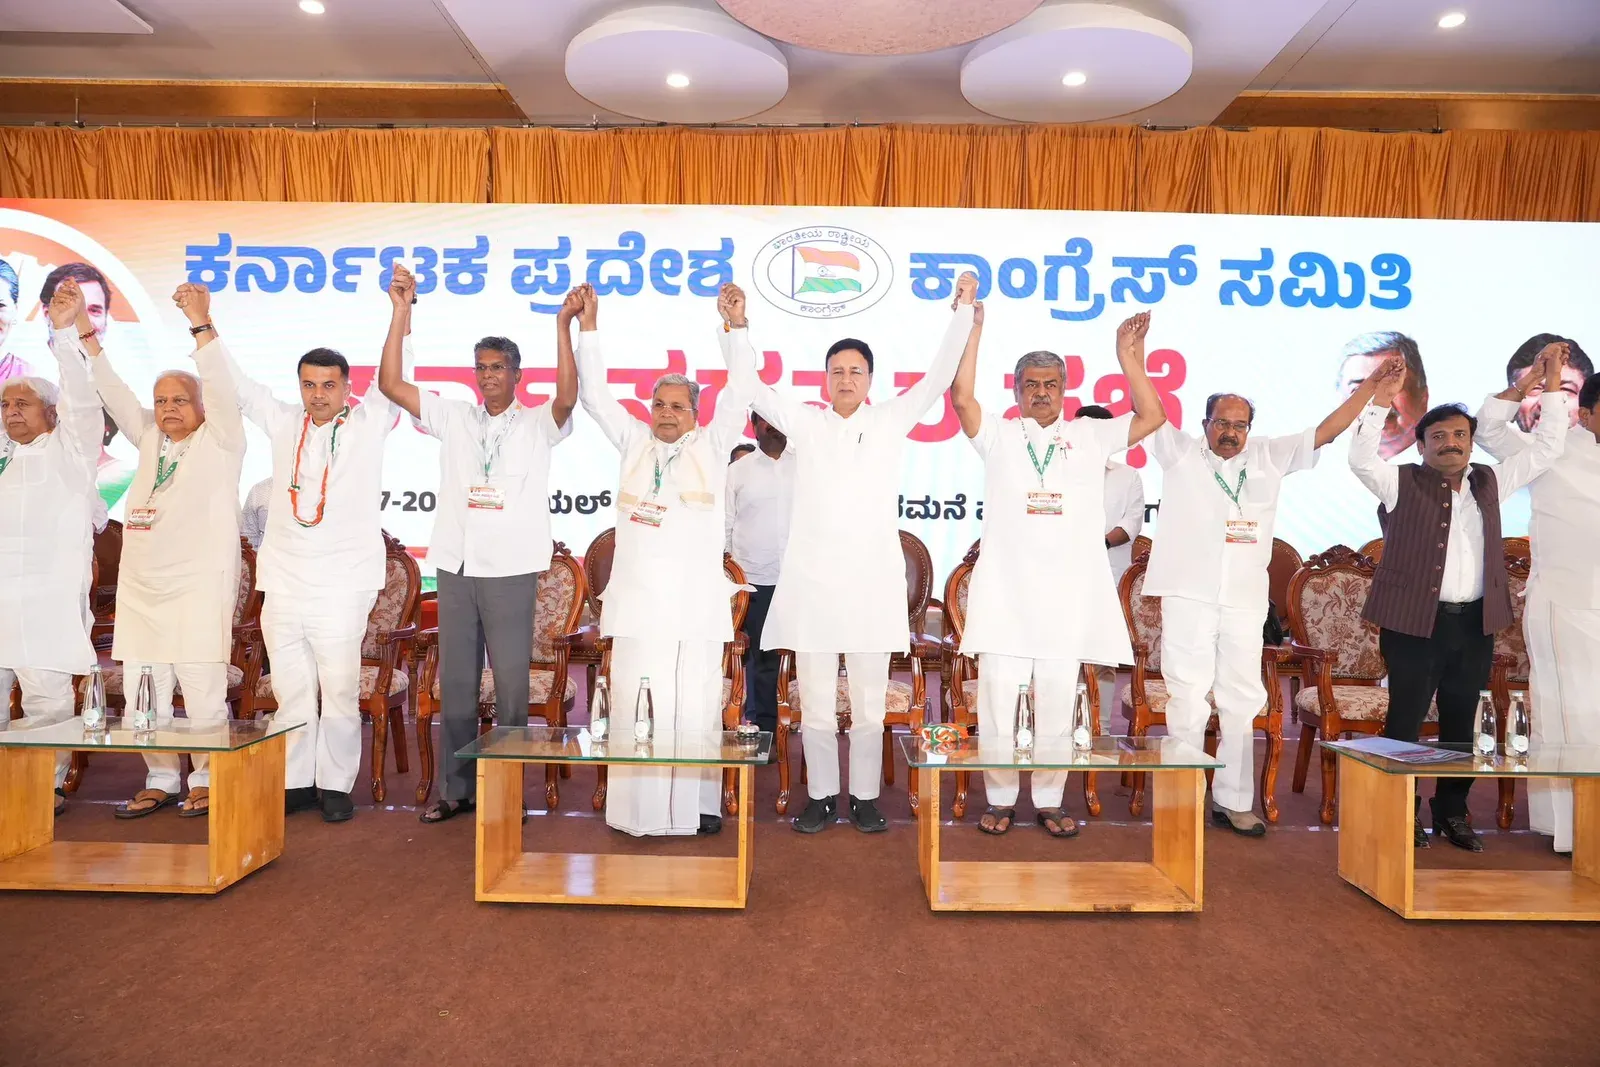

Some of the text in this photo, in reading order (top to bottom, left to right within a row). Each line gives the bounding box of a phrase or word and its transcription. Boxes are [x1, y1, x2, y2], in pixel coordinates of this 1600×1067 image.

[185, 231, 1413, 321] ಕರ್ನಾಟಕ ಪ್ರದೇಶ ಕಾಂಗ್ರೆಸ್ ಸಮಿತಿ
[800, 303, 847, 317] ಕಾಂಗ್ರೆಸ್
[898, 492, 967, 520] ಮನೆ
